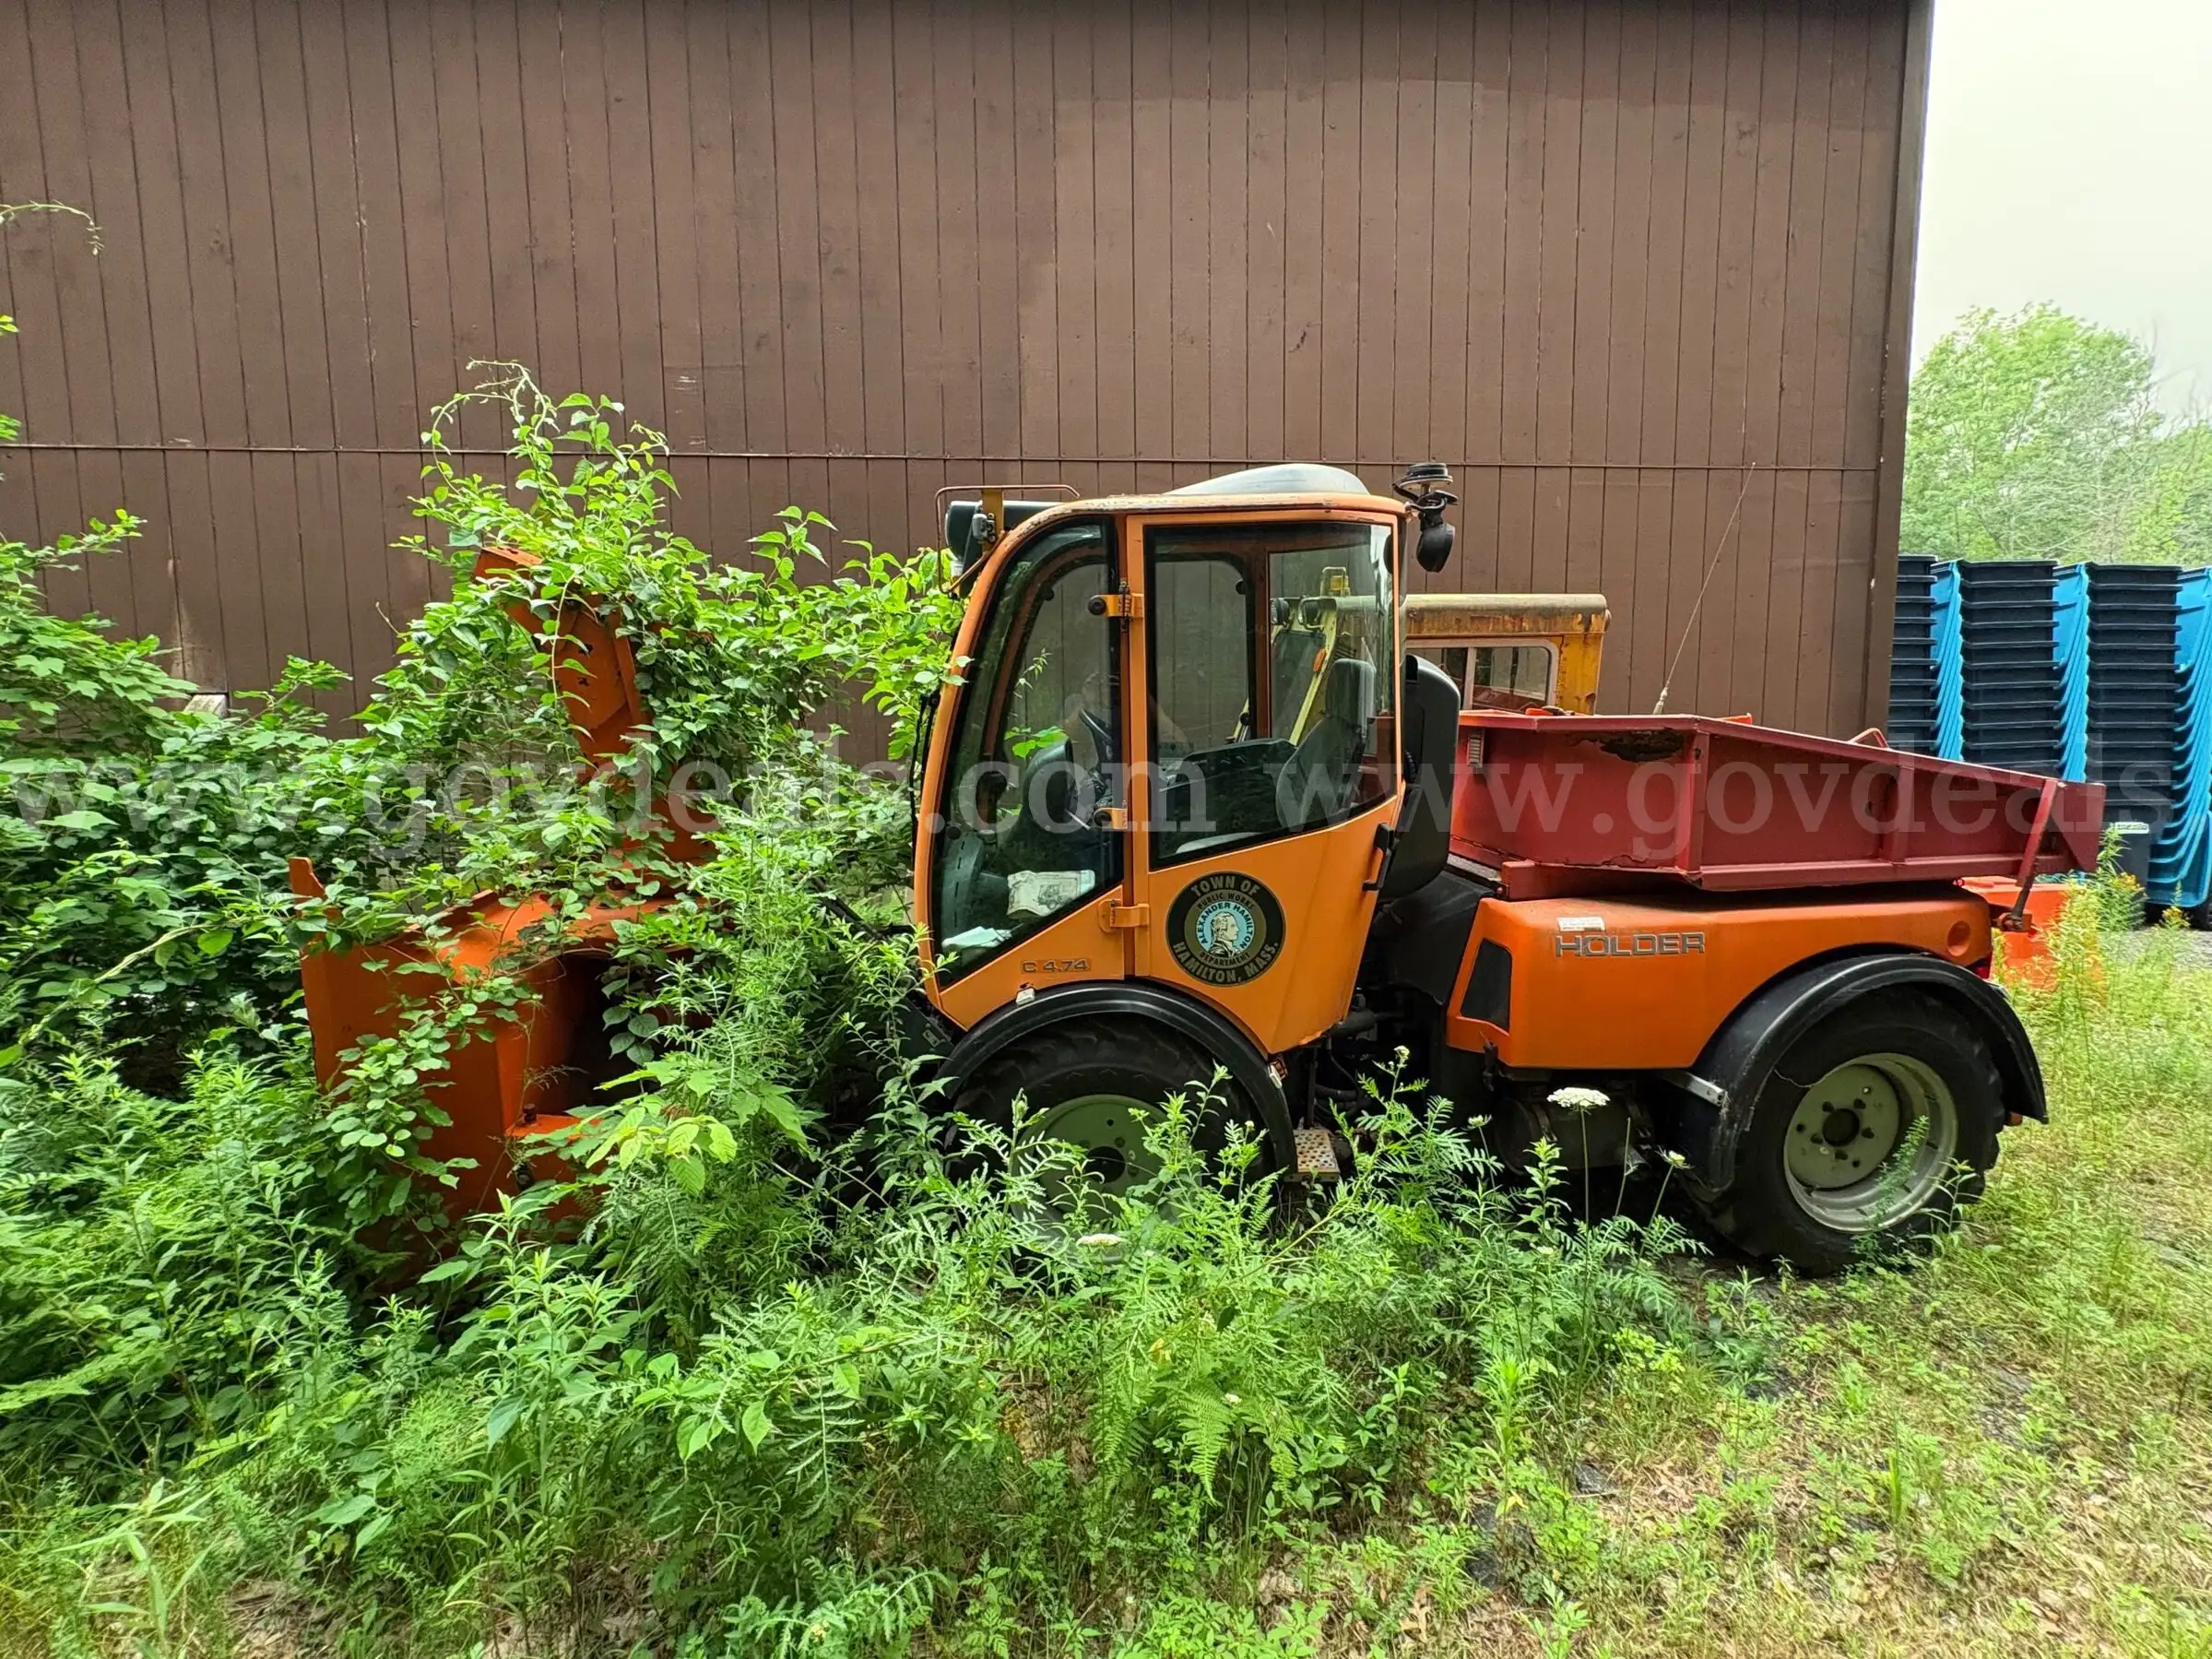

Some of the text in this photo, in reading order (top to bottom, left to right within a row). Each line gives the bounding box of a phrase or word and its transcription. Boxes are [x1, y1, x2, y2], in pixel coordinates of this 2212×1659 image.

[1190, 876, 1260, 897] TOWN OF
[1197, 892, 1255, 909] PUBLIC WORKS
[1198, 902, 1254, 949] ALEXANDER HAMILTON
[1555, 931, 1705, 957] HOLDER
[1022, 960, 1038, 973] C
[1172, 941, 1280, 983] HAMILTON, MASS.
[1200, 952, 1250, 966] DEPARTMENT
